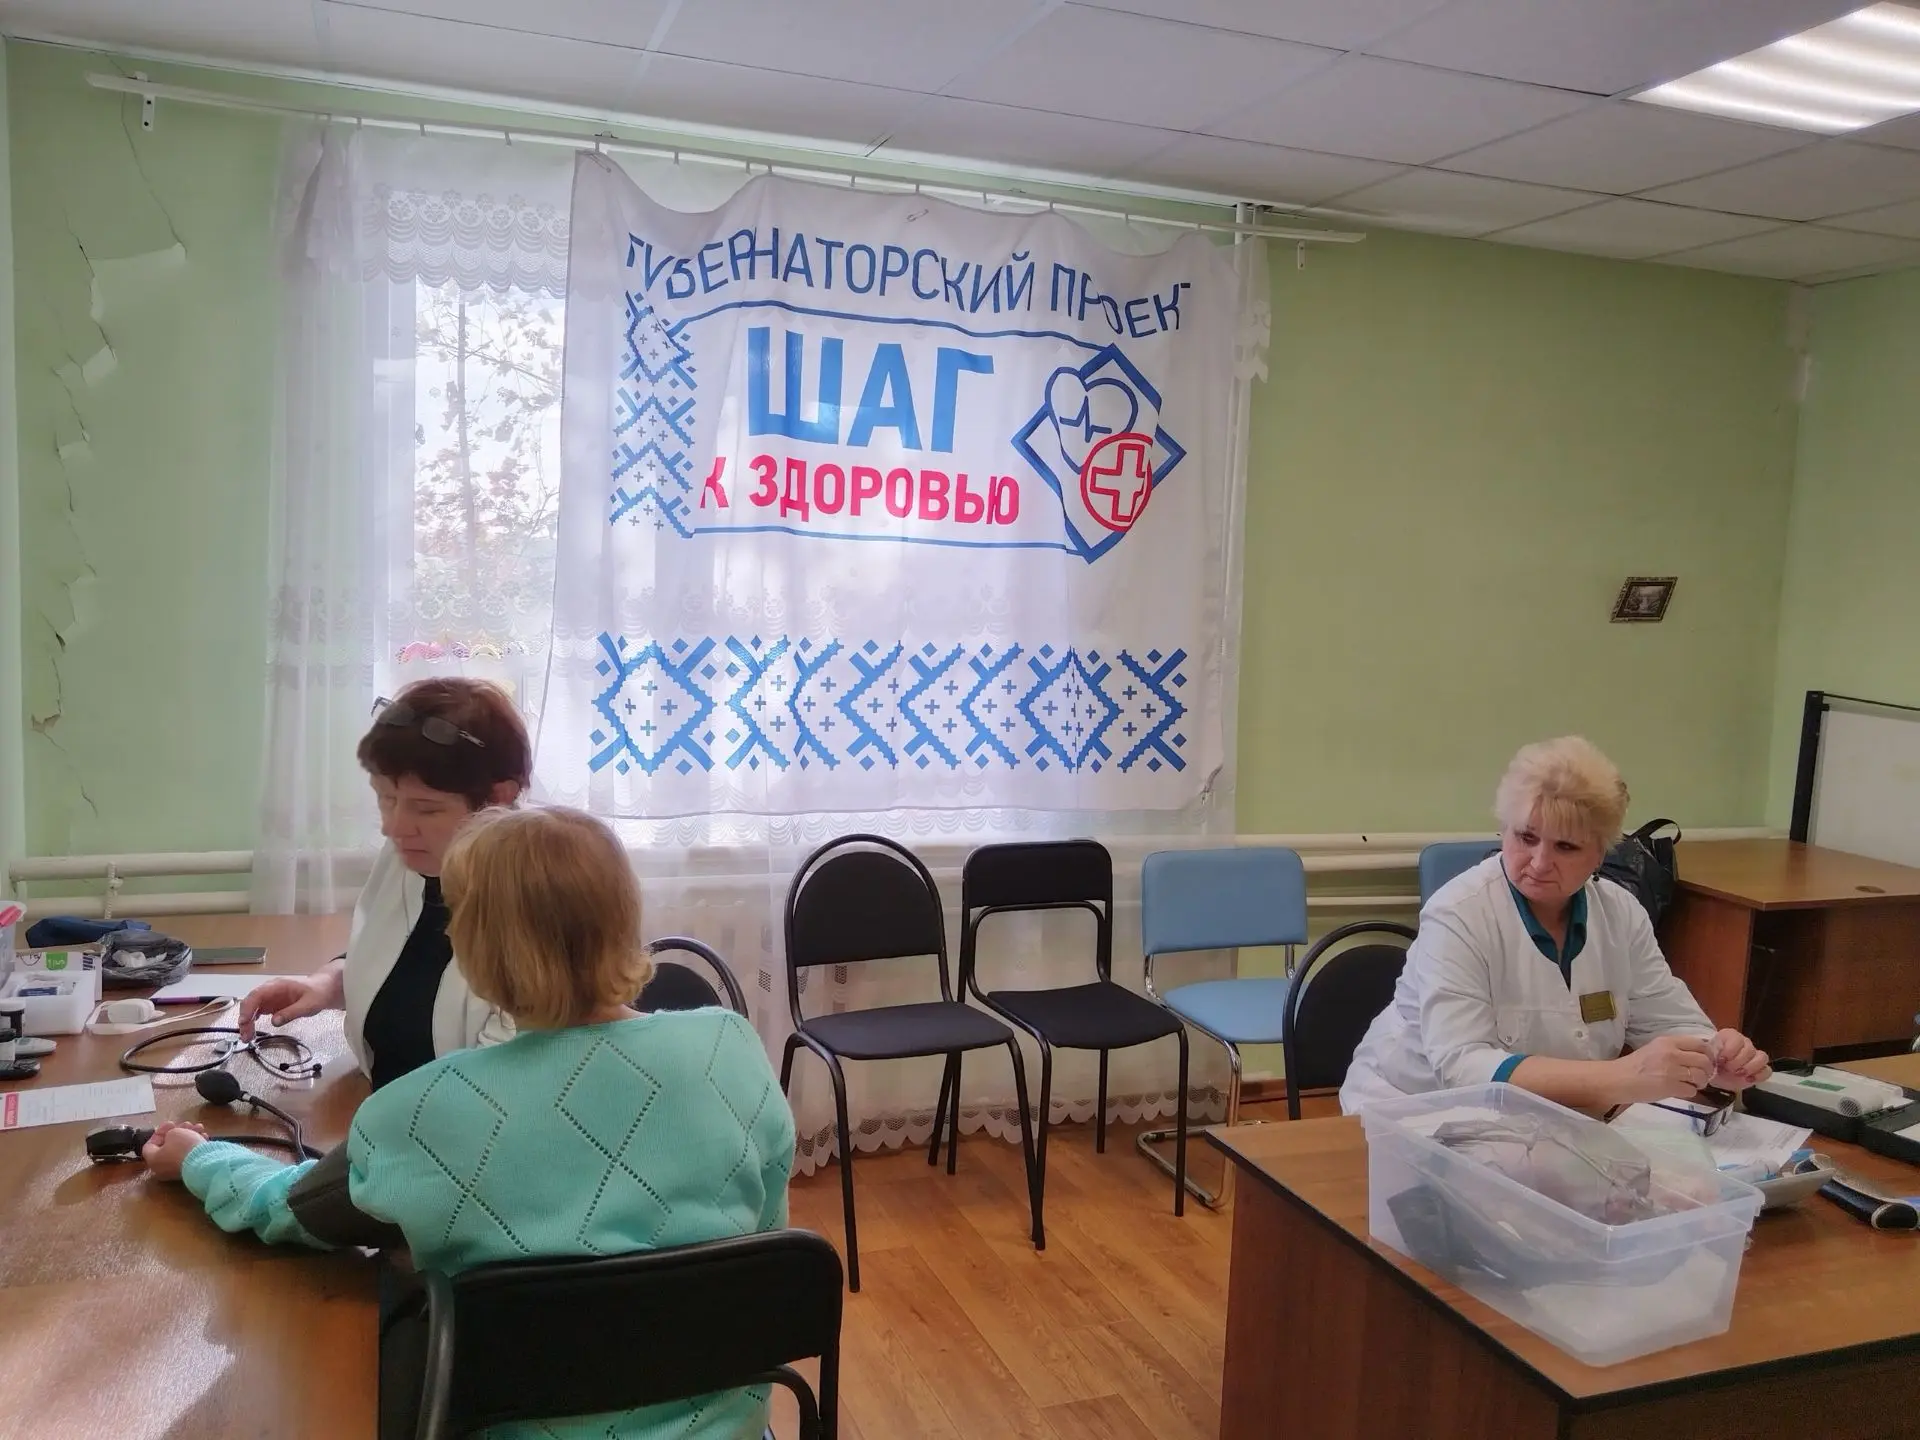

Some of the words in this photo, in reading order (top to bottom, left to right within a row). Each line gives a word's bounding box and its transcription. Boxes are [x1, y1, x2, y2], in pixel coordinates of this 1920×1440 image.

[1051, 262, 1191, 338] ПРОЕК
[748, 327, 994, 453] ШАГ
[700, 456, 729, 509] К
[749, 454, 1020, 525] ЗДОРОВЬЮ
